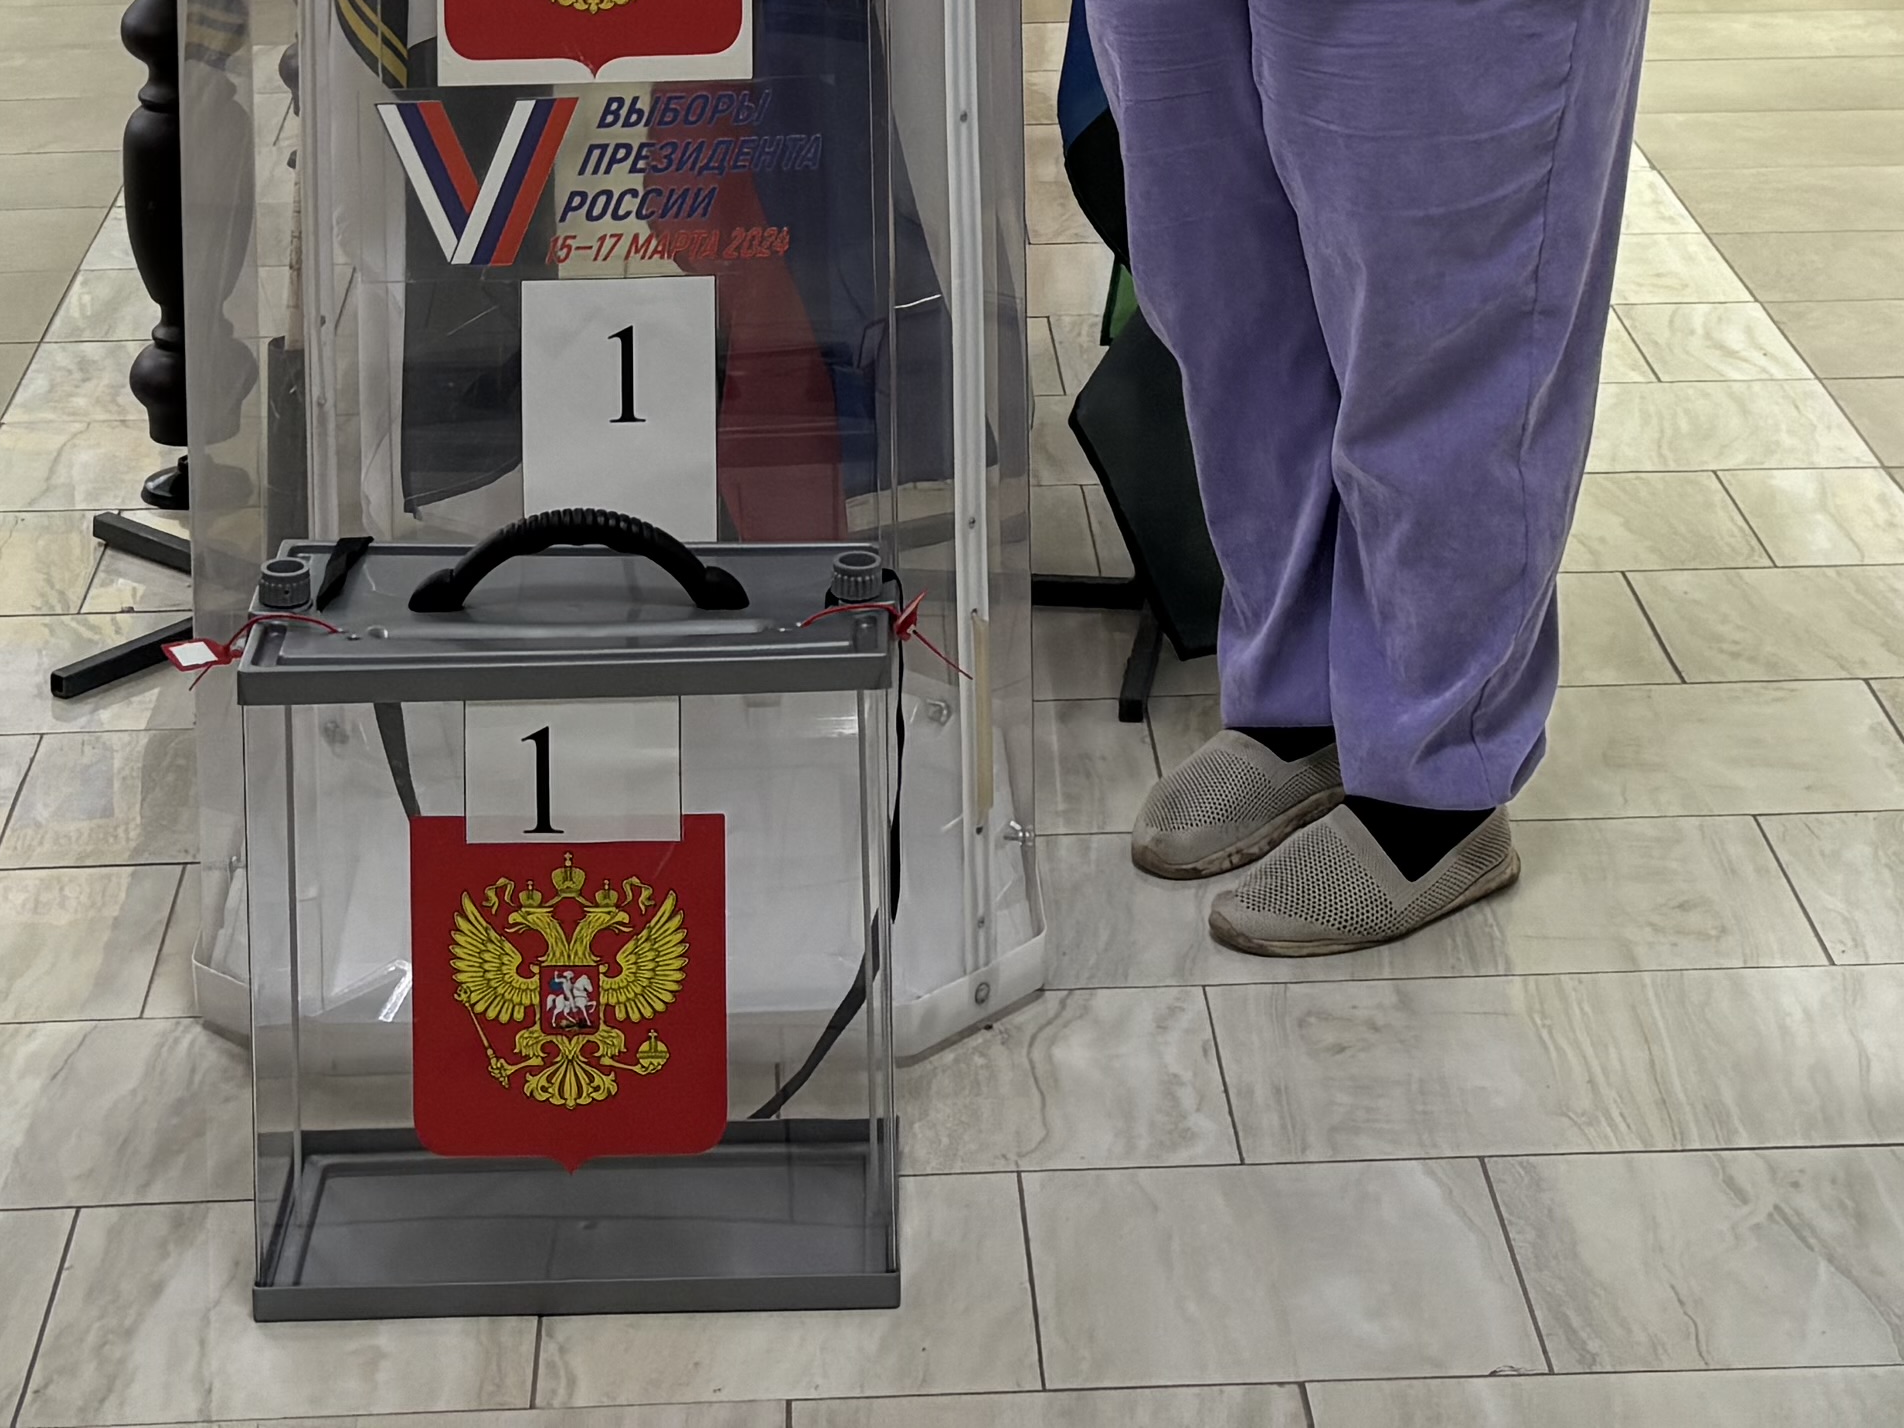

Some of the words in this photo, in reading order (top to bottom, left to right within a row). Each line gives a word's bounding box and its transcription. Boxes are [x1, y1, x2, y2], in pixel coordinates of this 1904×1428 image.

[596, 89, 772, 129] ВЫБОРЫ
[577, 133, 823, 176] ПРЕЗИДЕНТА
[558, 187, 719, 223] РОССИИ
[624, 230, 718, 262] МАРТА
[723, 226, 791, 260] 2024
[607, 325, 647, 424] 1
[521, 725, 565, 834] 1
